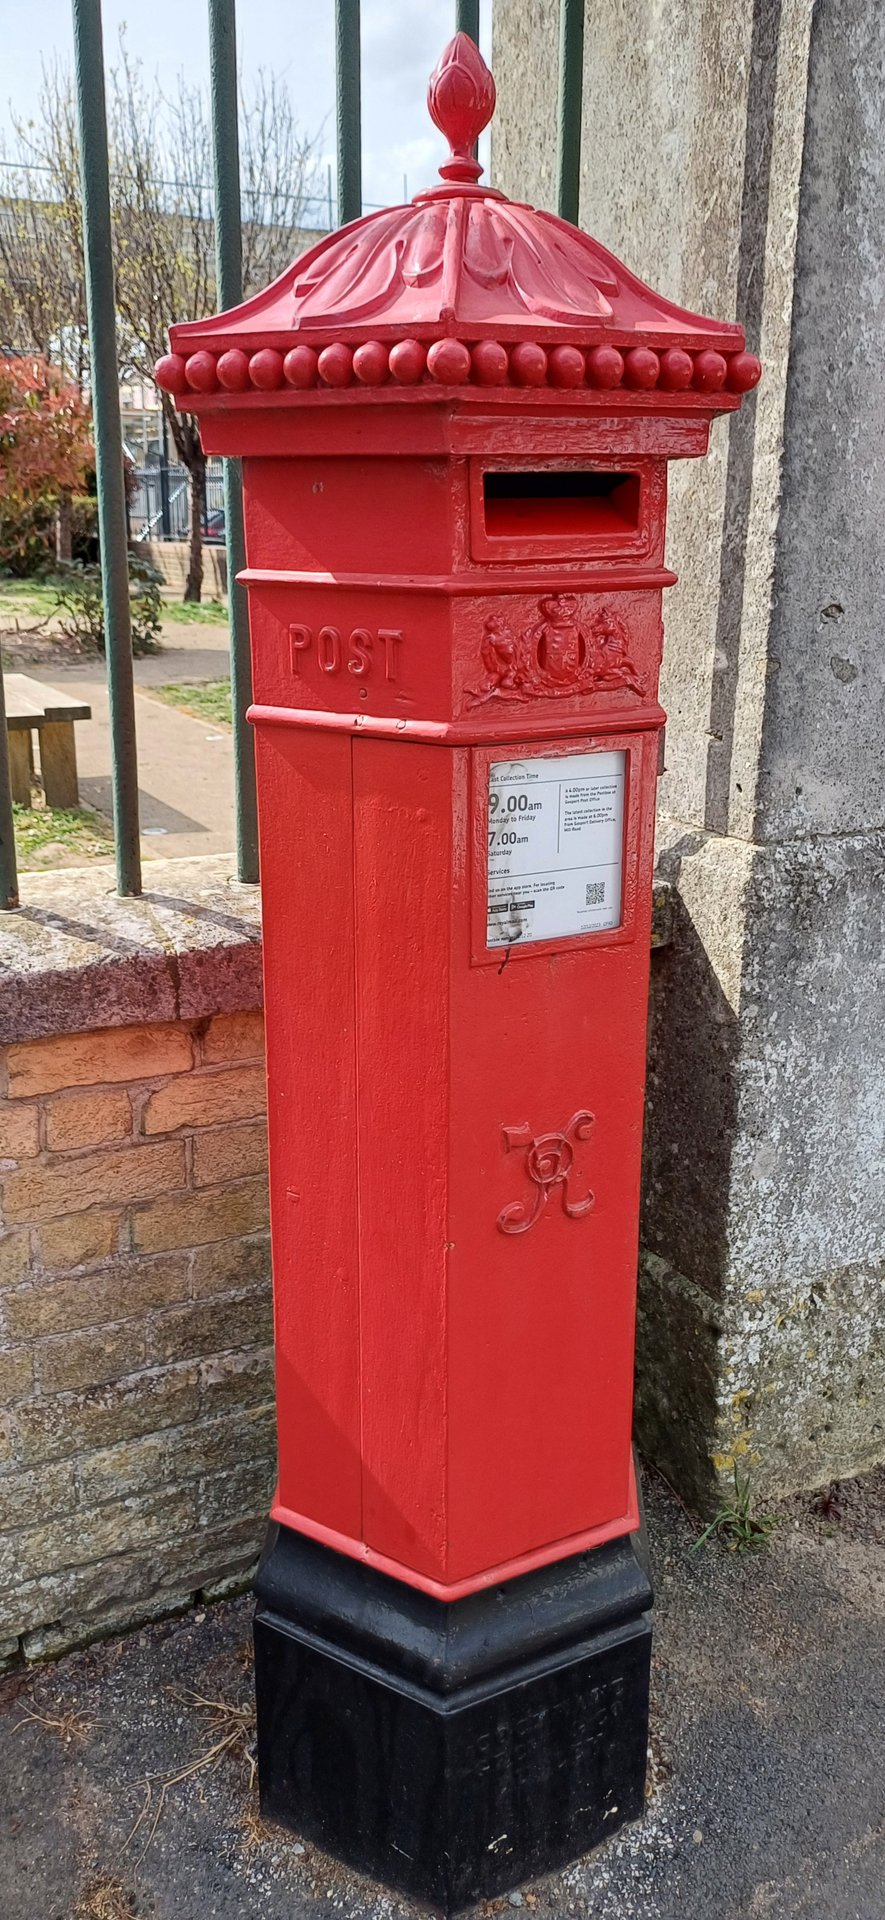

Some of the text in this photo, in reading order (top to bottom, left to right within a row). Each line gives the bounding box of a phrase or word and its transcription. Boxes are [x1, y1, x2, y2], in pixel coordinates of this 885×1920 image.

[288, 623, 404, 681] POST
[488, 793, 542, 814] 9.00am
[518, 814, 536, 822] Friday
[488, 831, 529, 847] 7.00am
[488, 849, 512, 857] Saturday
